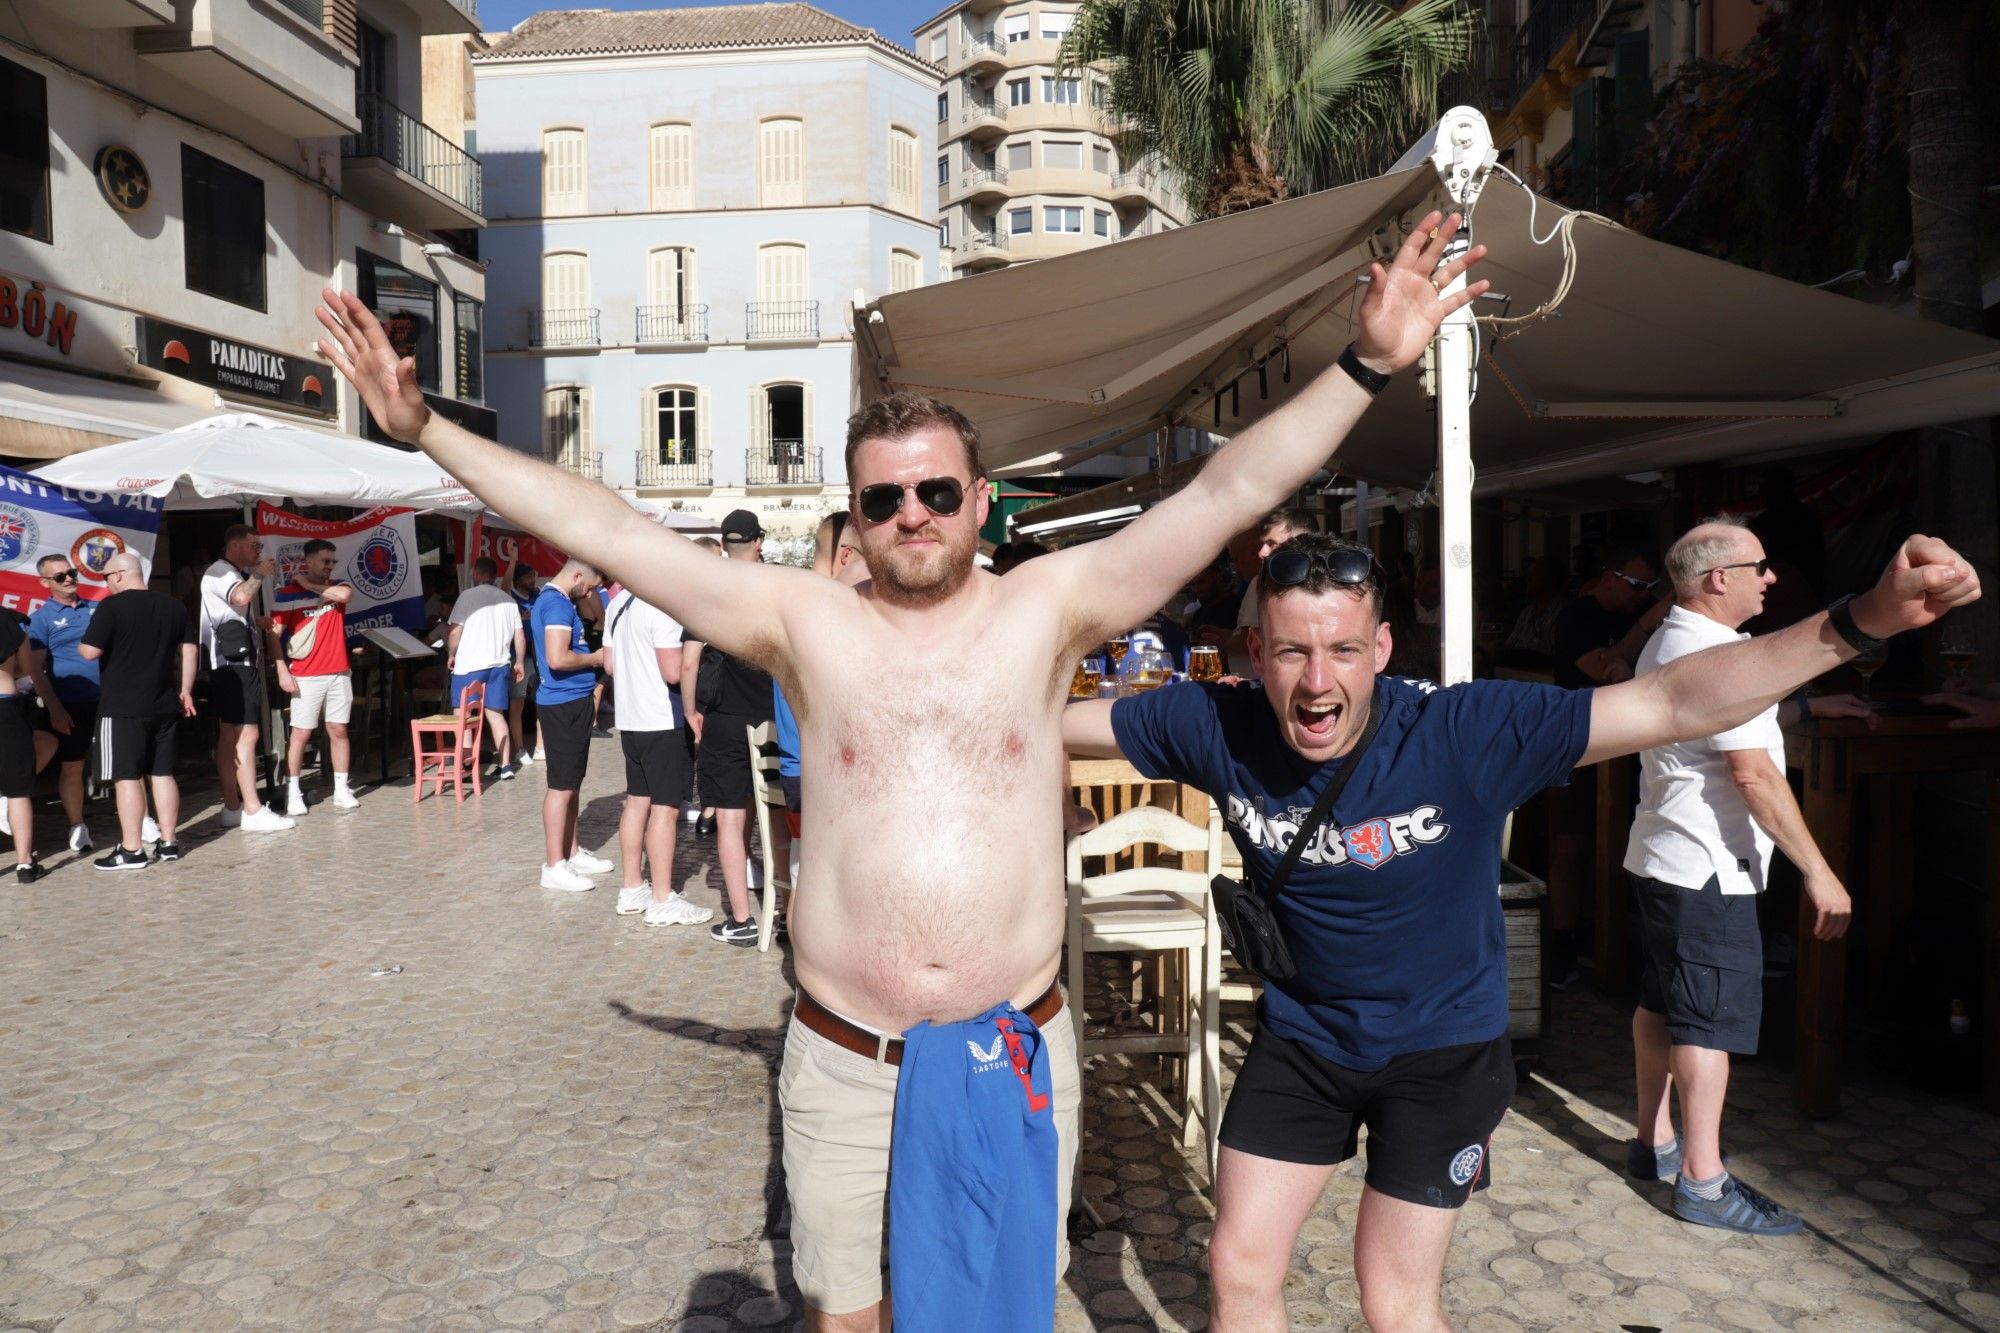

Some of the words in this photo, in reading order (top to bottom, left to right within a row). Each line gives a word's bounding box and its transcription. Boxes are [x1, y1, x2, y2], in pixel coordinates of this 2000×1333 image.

[210, 339, 286, 381] PANADITAS
[217, 369, 253, 389] EMPANADAS
[254, 378, 281, 394] GOURMET
[61, 486, 158, 513] LOYAL
[1386, 805, 1450, 856] FC
